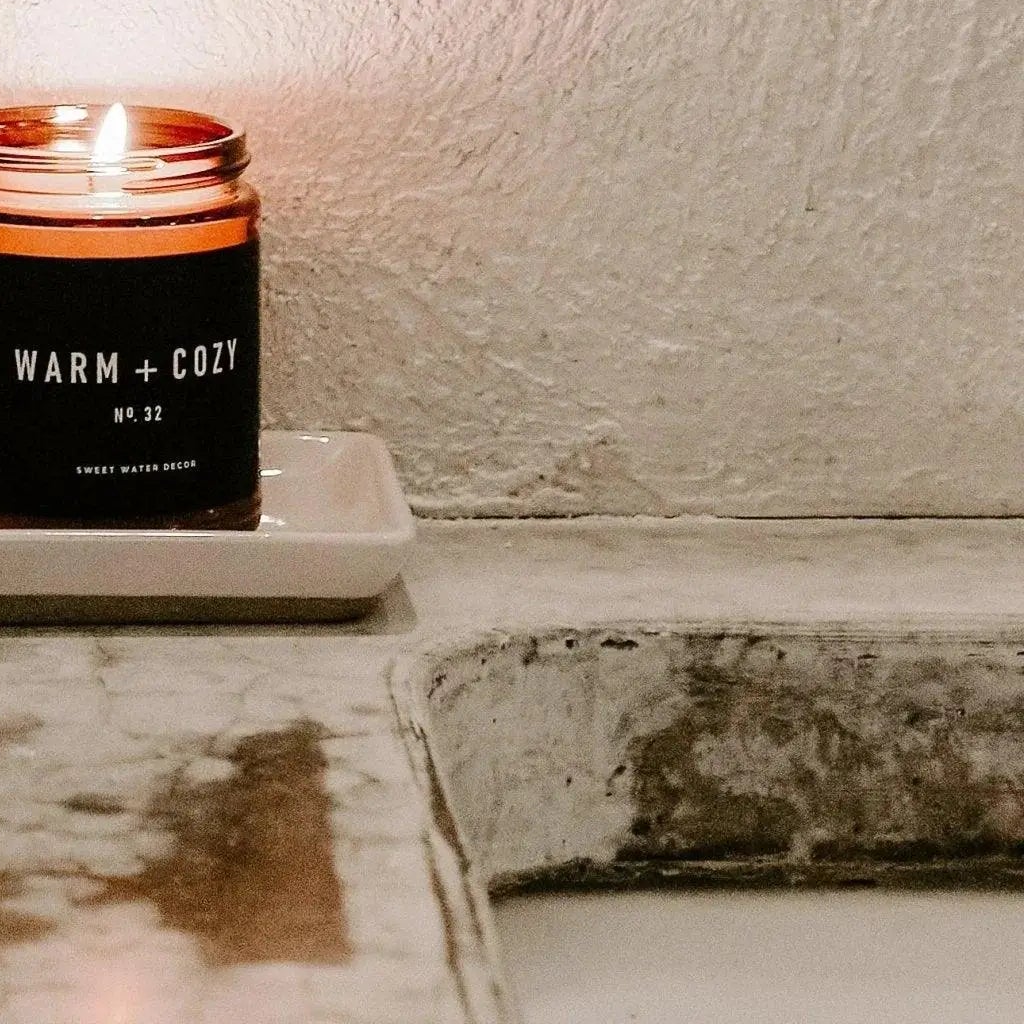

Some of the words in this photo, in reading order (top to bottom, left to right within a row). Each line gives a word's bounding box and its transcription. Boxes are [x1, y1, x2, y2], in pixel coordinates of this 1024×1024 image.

[14, 348, 119, 384] WARM
[134, 359, 158, 382] +
[172, 338, 238, 380] COZY
[76, 465, 115, 475] SWEET
[120, 463, 159, 474] WATER
[163, 459, 197, 471] DECOR
